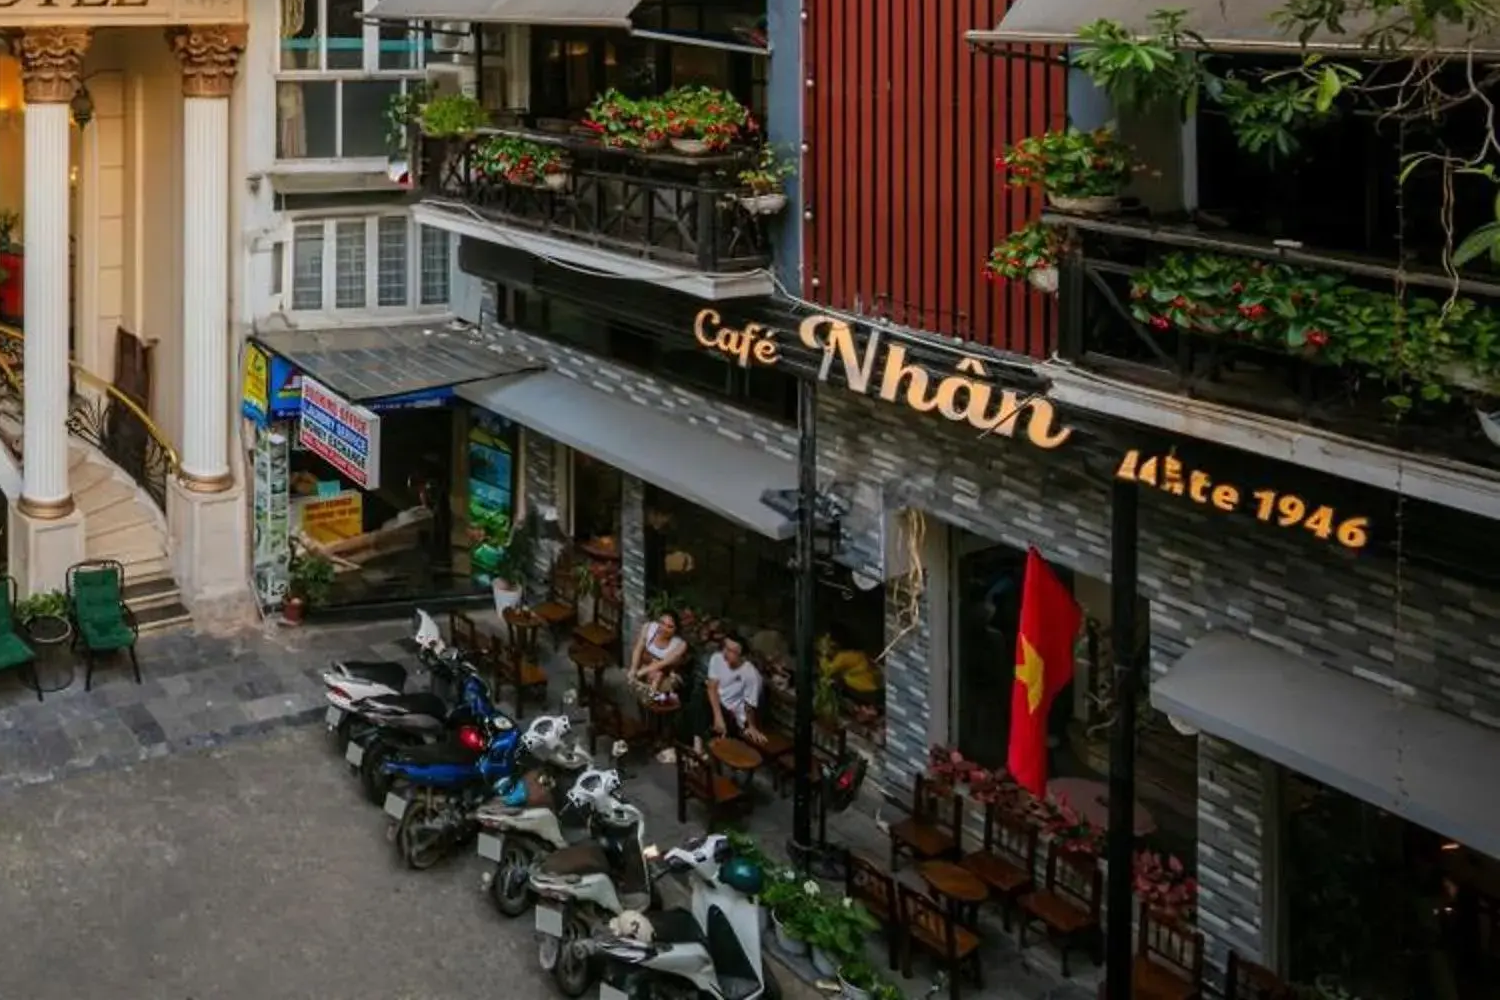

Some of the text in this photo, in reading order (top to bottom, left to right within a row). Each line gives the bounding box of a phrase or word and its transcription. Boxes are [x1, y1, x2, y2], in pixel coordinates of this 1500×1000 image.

[693, 308, 1073, 450] Café Nhân
[1252, 488, 1371, 548] 1946
